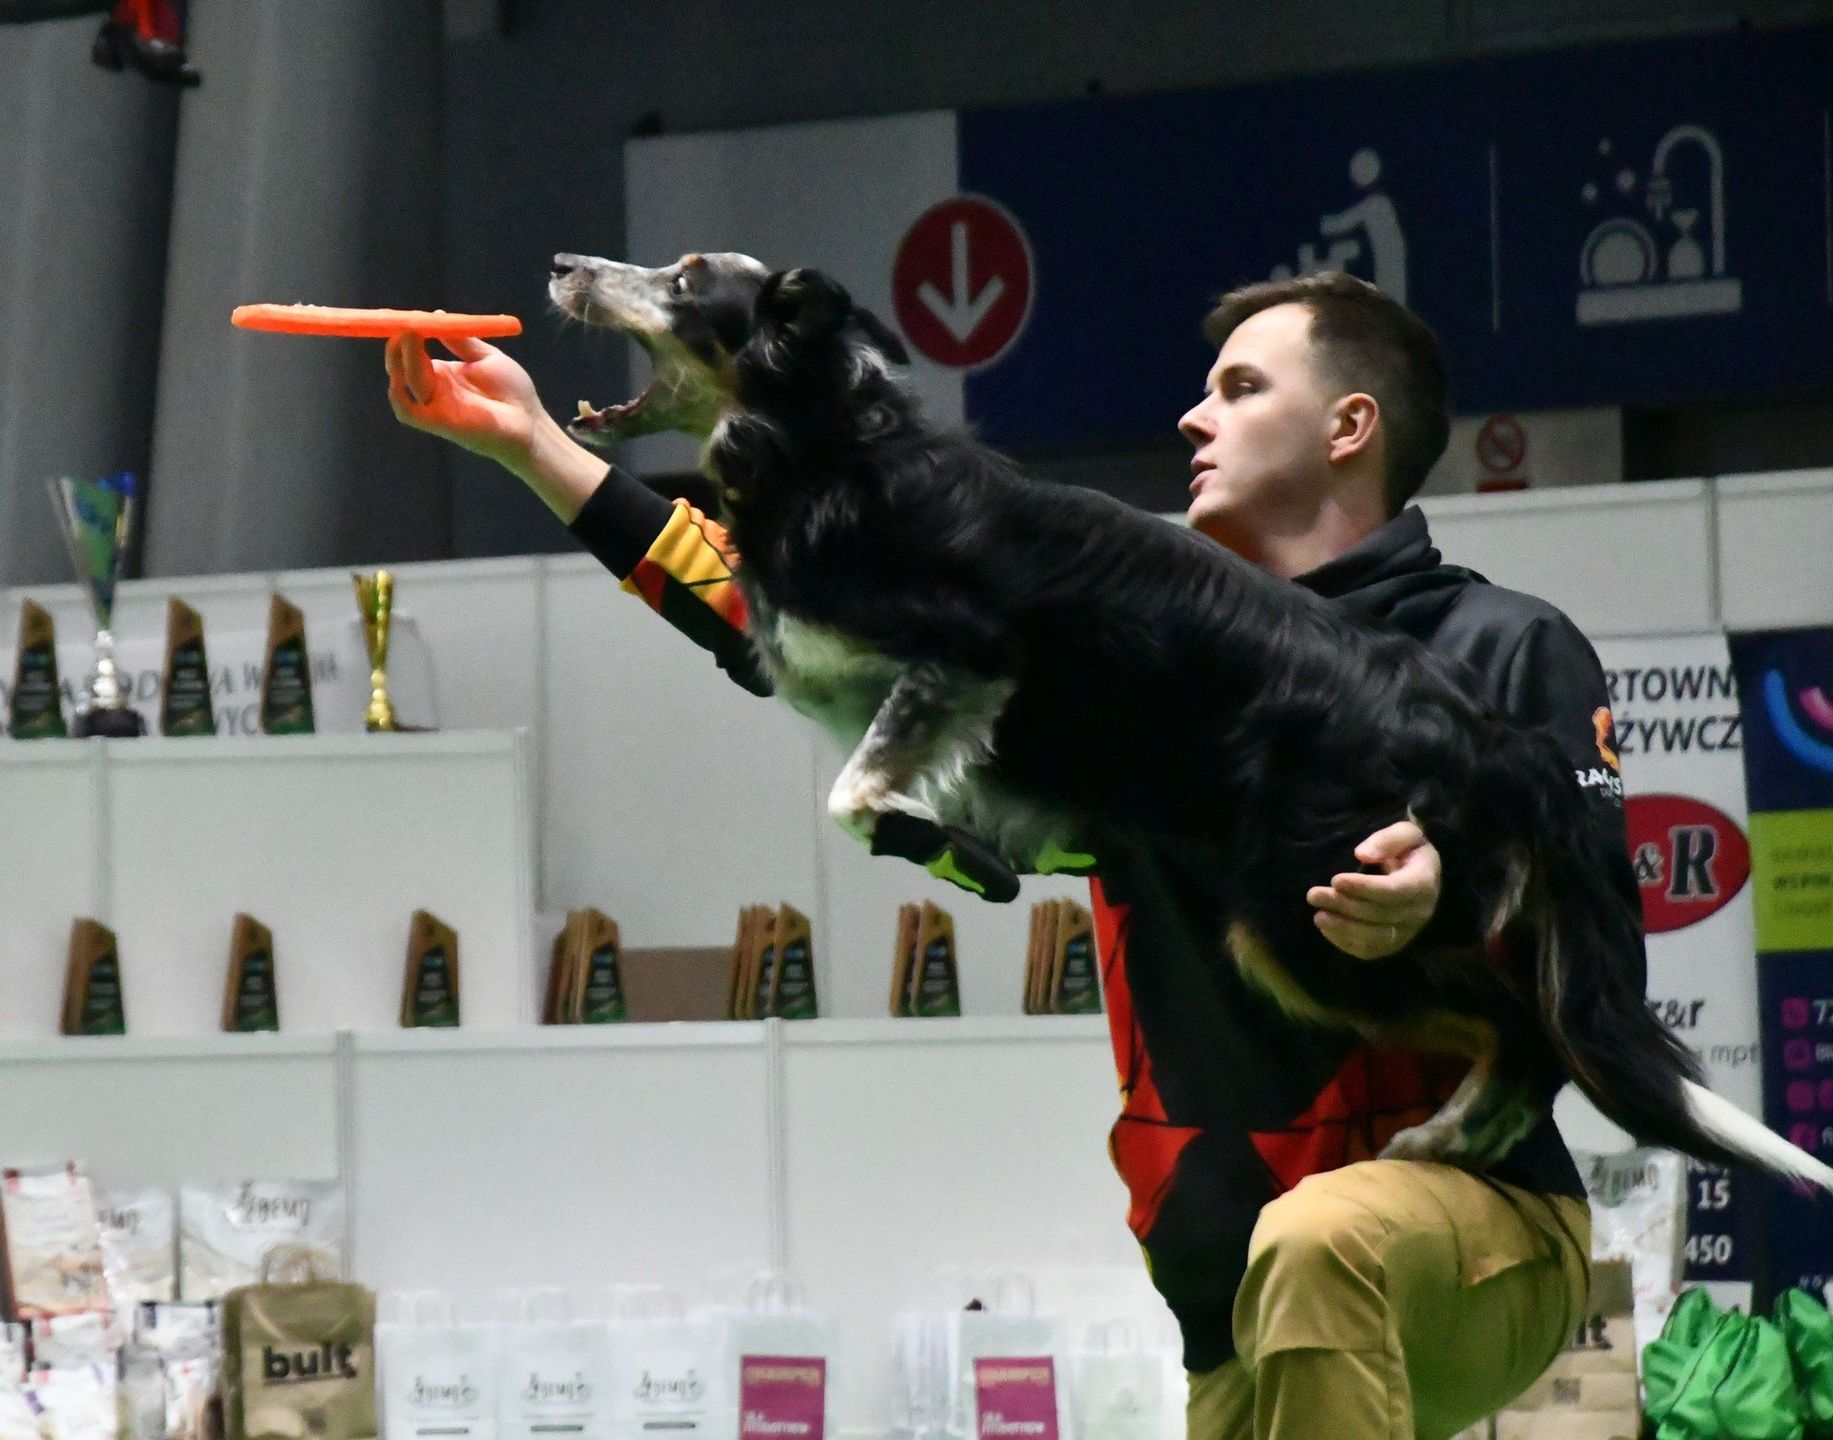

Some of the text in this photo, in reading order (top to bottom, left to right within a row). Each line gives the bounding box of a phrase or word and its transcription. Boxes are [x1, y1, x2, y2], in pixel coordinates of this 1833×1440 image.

[1615, 711, 1742, 753] ŻYWCZ
[1698, 1179, 1731, 1210] 15
[1686, 1235, 1733, 1264] 450
[262, 1338, 357, 1380] bult
